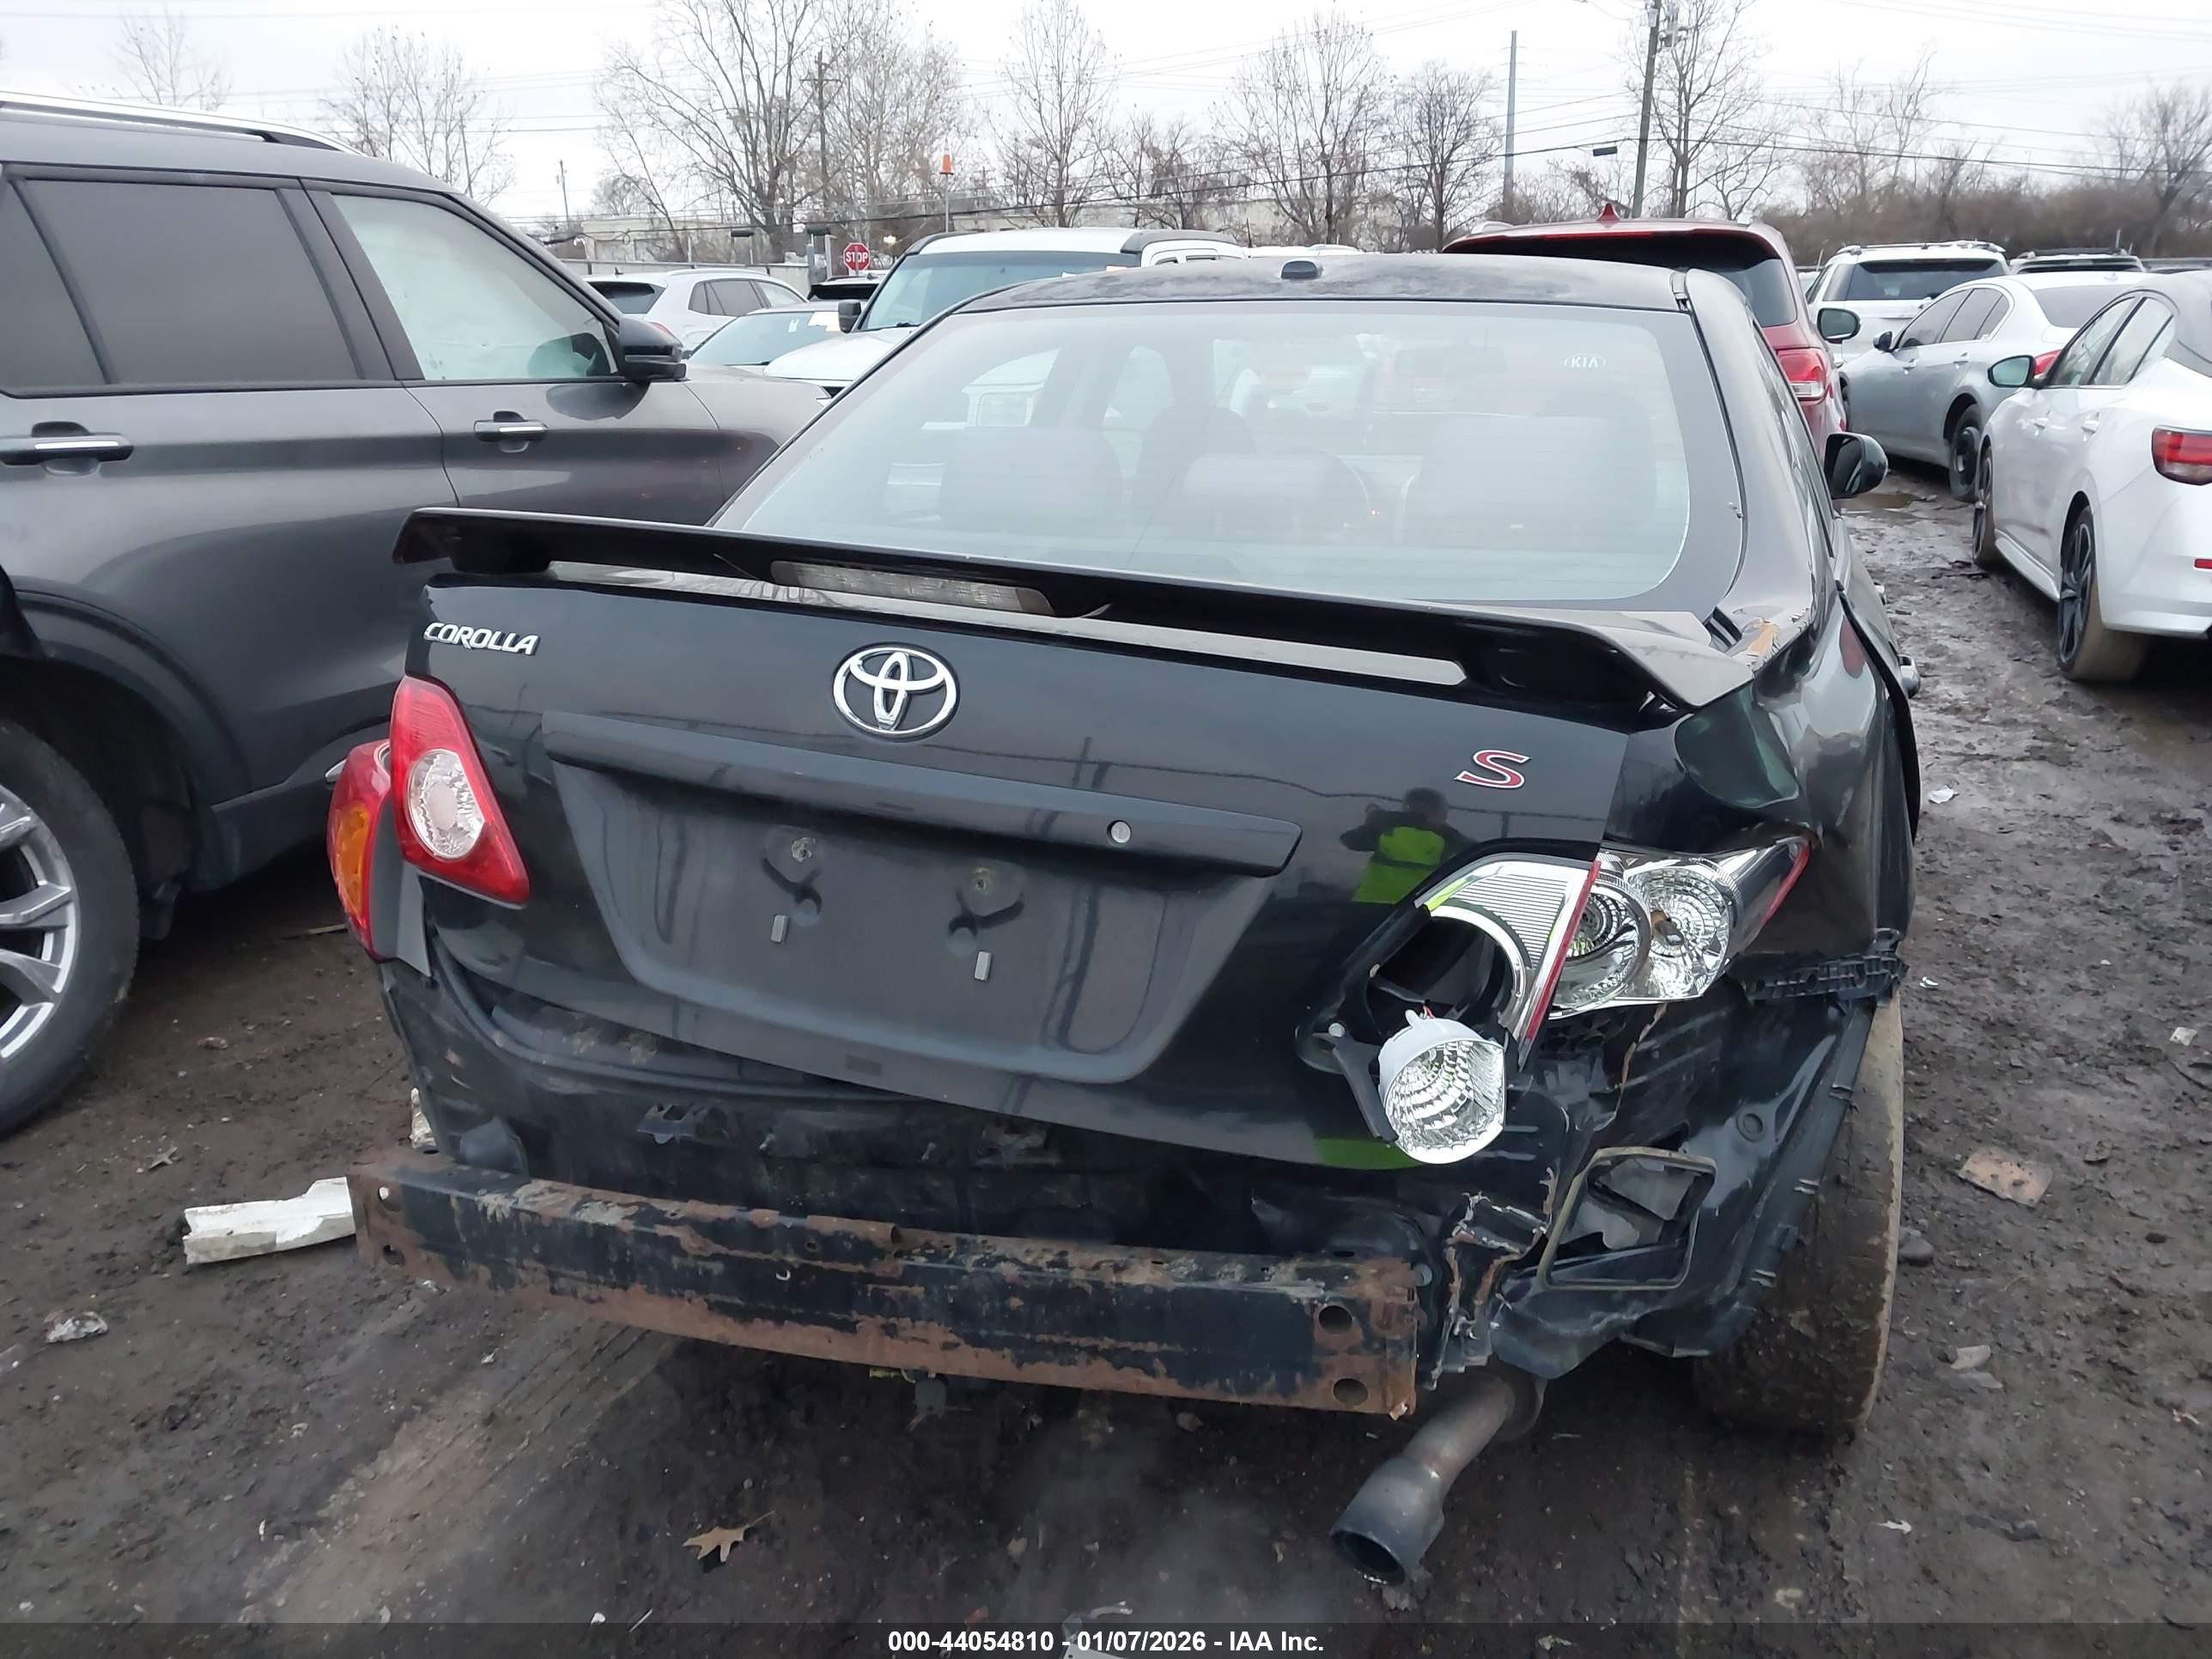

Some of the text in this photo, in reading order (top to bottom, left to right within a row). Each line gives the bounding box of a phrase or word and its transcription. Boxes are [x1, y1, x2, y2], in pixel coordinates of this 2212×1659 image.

[845, 251, 868, 264] STOP
[1571, 356, 1598, 368] KIA
[422, 622, 539, 655] COROLLA
[1454, 749, 1531, 789] S
